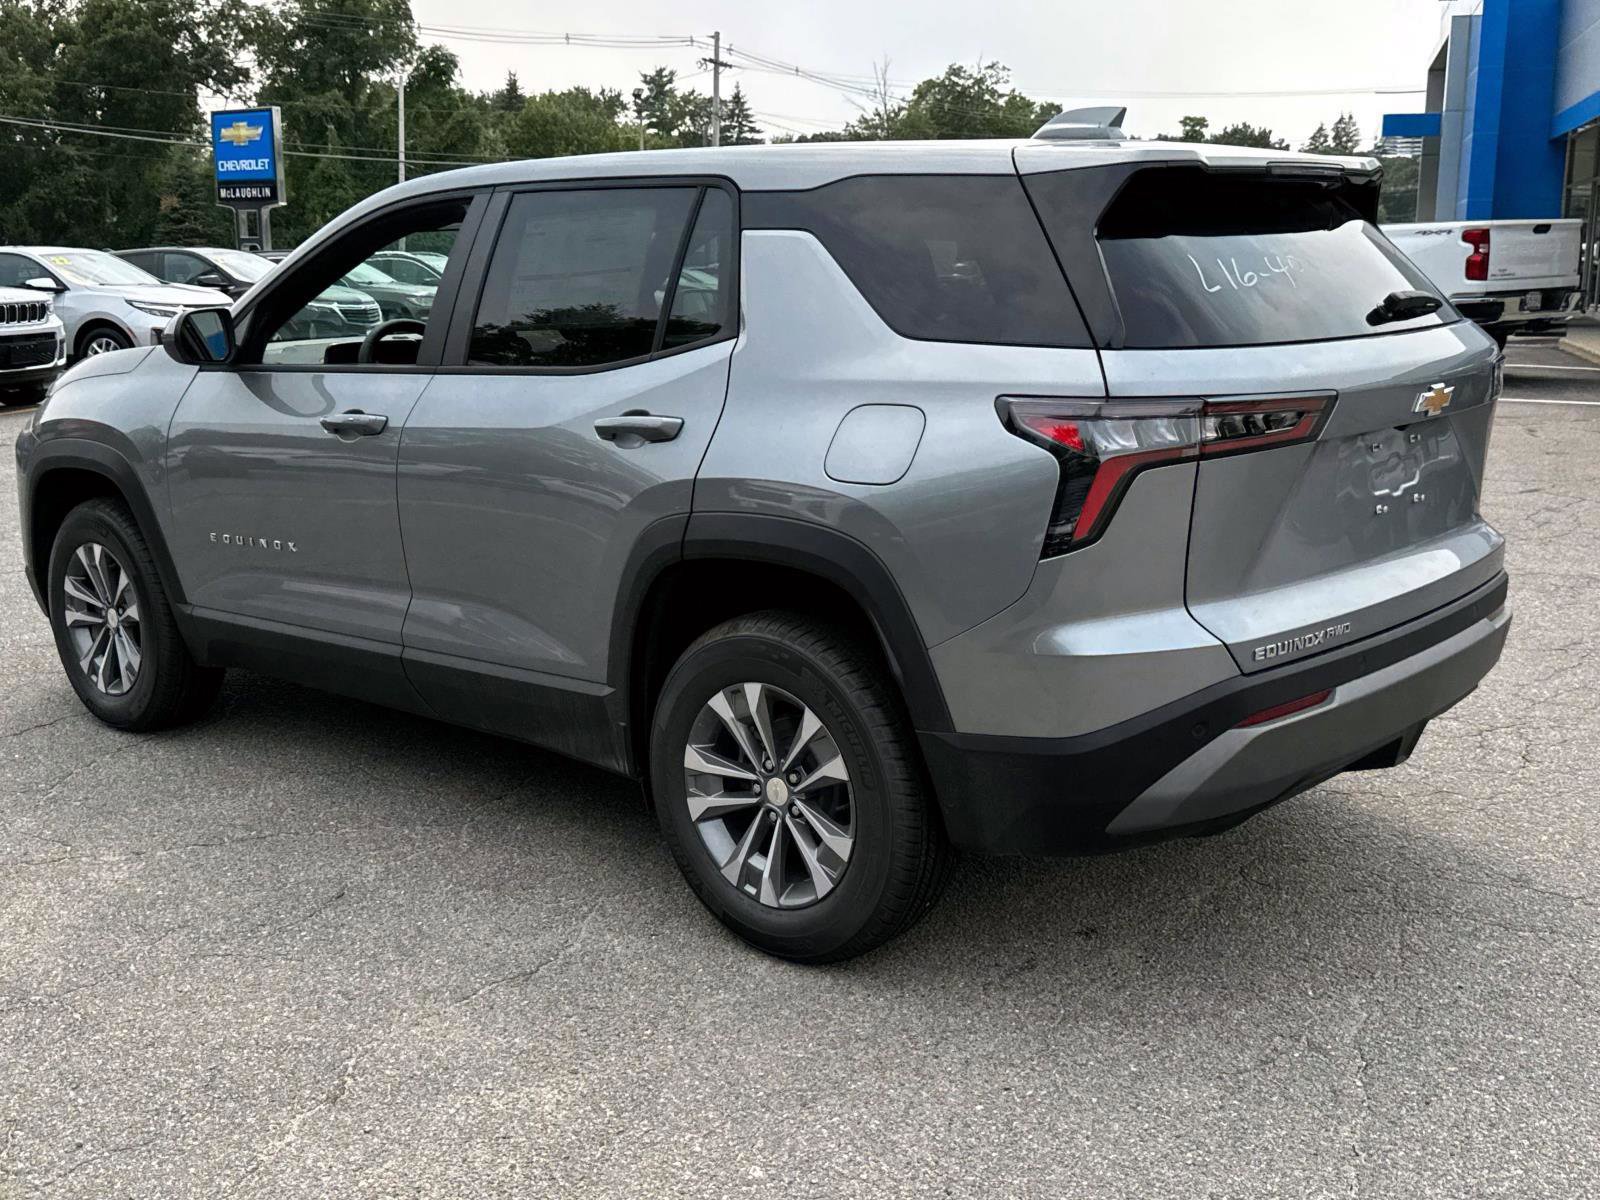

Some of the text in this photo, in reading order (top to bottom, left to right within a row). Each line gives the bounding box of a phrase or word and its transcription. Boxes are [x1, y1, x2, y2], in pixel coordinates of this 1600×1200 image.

[218, 159, 270, 171] CHEVROLET
[220, 187, 271, 198] McLAUGHLIN
[209, 532, 297, 552] EQUINOX
[1253, 622, 1351, 661] EQUINOX AWD
